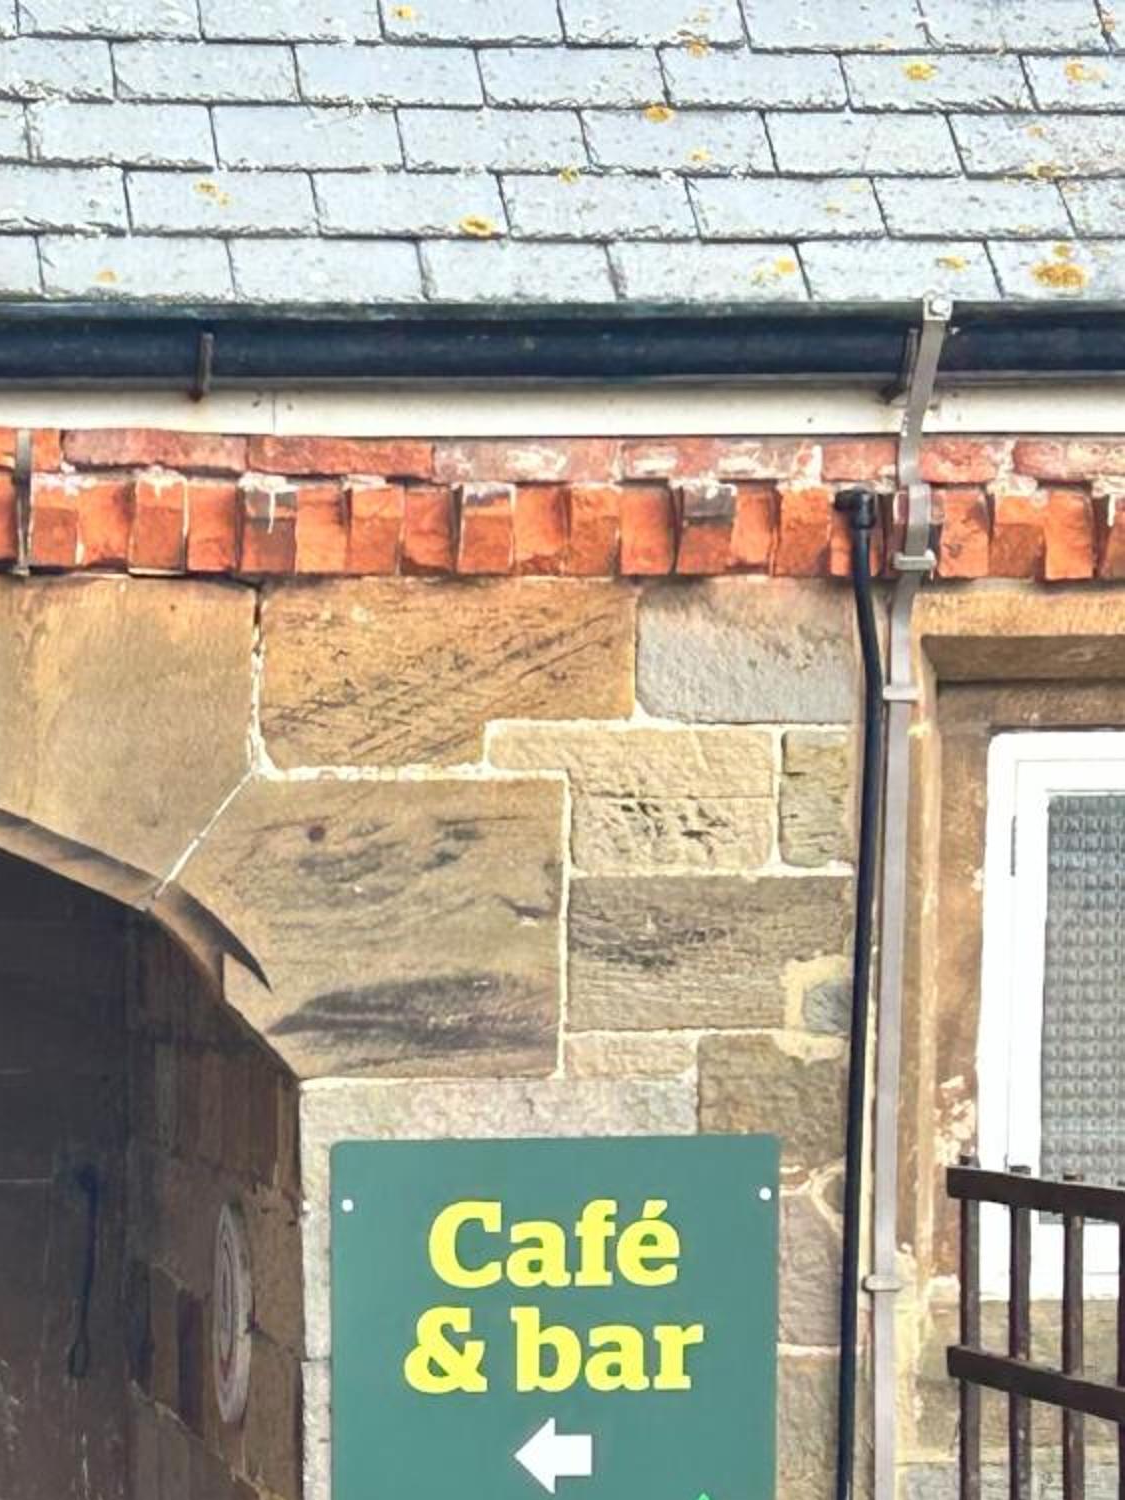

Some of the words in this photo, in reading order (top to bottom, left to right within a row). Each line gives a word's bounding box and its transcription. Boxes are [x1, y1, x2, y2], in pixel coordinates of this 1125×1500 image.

[428, 1199, 681, 1288] Café
[403, 1306, 488, 1394] &
[510, 1306, 704, 1392] bar
